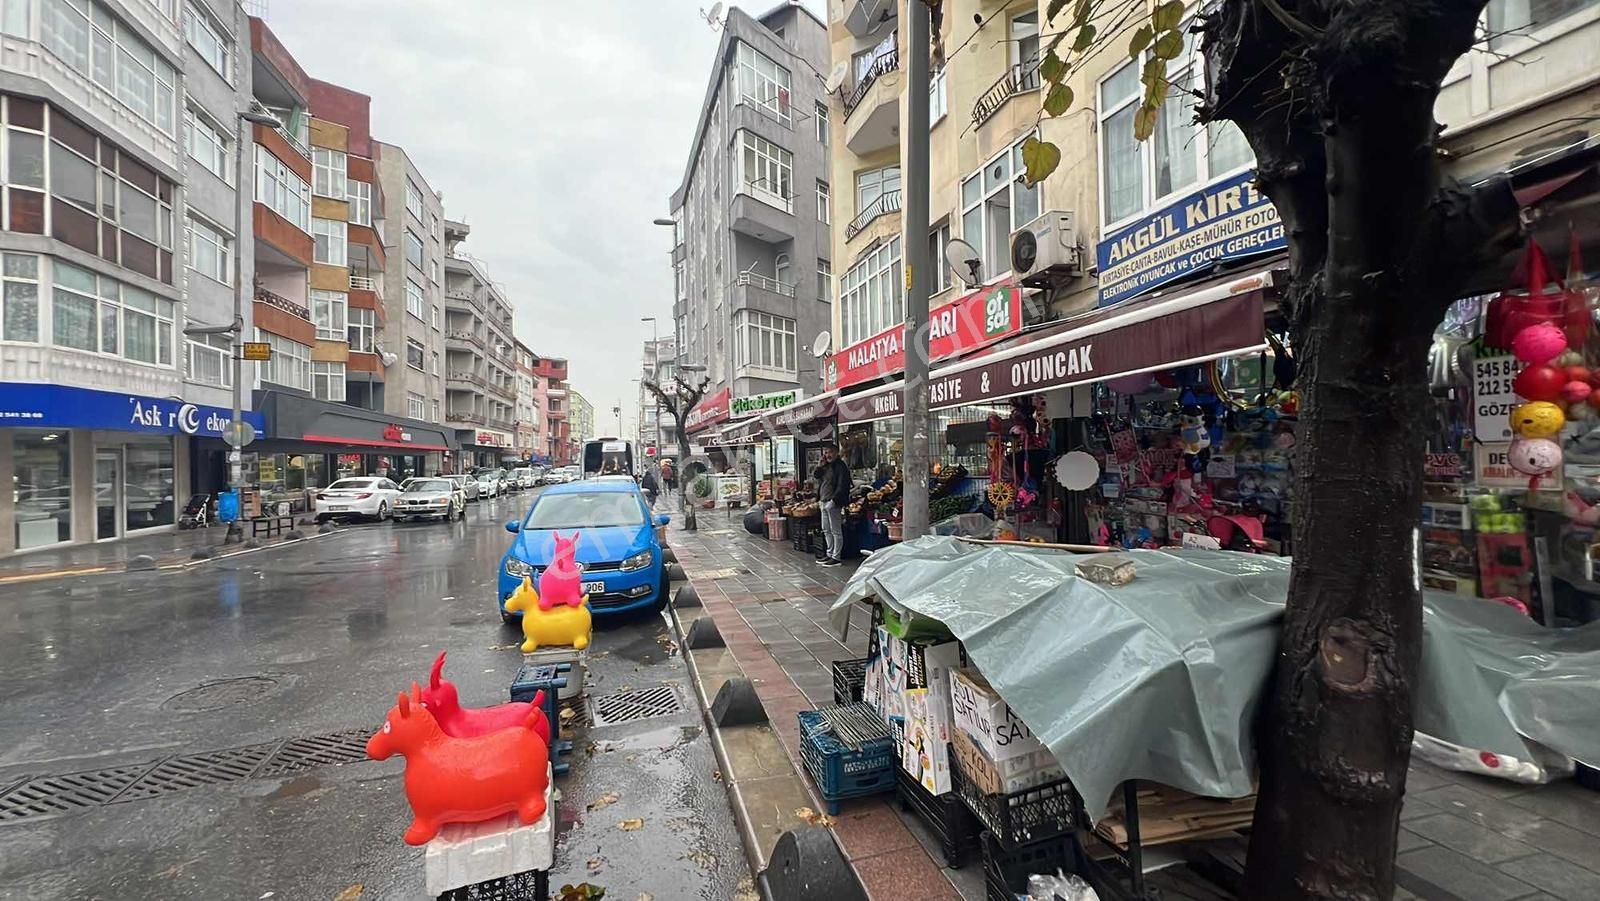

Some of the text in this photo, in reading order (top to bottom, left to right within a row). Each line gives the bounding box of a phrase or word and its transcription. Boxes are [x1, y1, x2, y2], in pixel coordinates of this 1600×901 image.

[1109, 179, 1269, 265] AKGÜL KIRT
[1245, 207, 1280, 228] FOTO
[1140, 261, 1176, 285] OYUNCAK
[1178, 260, 1188, 270] ve
[1190, 243, 1225, 268] ÇOCUK
[848, 333, 898, 370] MALATYA
[875, 345, 1093, 414] AKGÜL ASİYE & OYUNCAK
[1477, 362, 1499, 378] 545
[1478, 380, 1500, 395] 212
[1489, 453, 1510, 465] DE
[996, 720, 1031, 746] SAT
